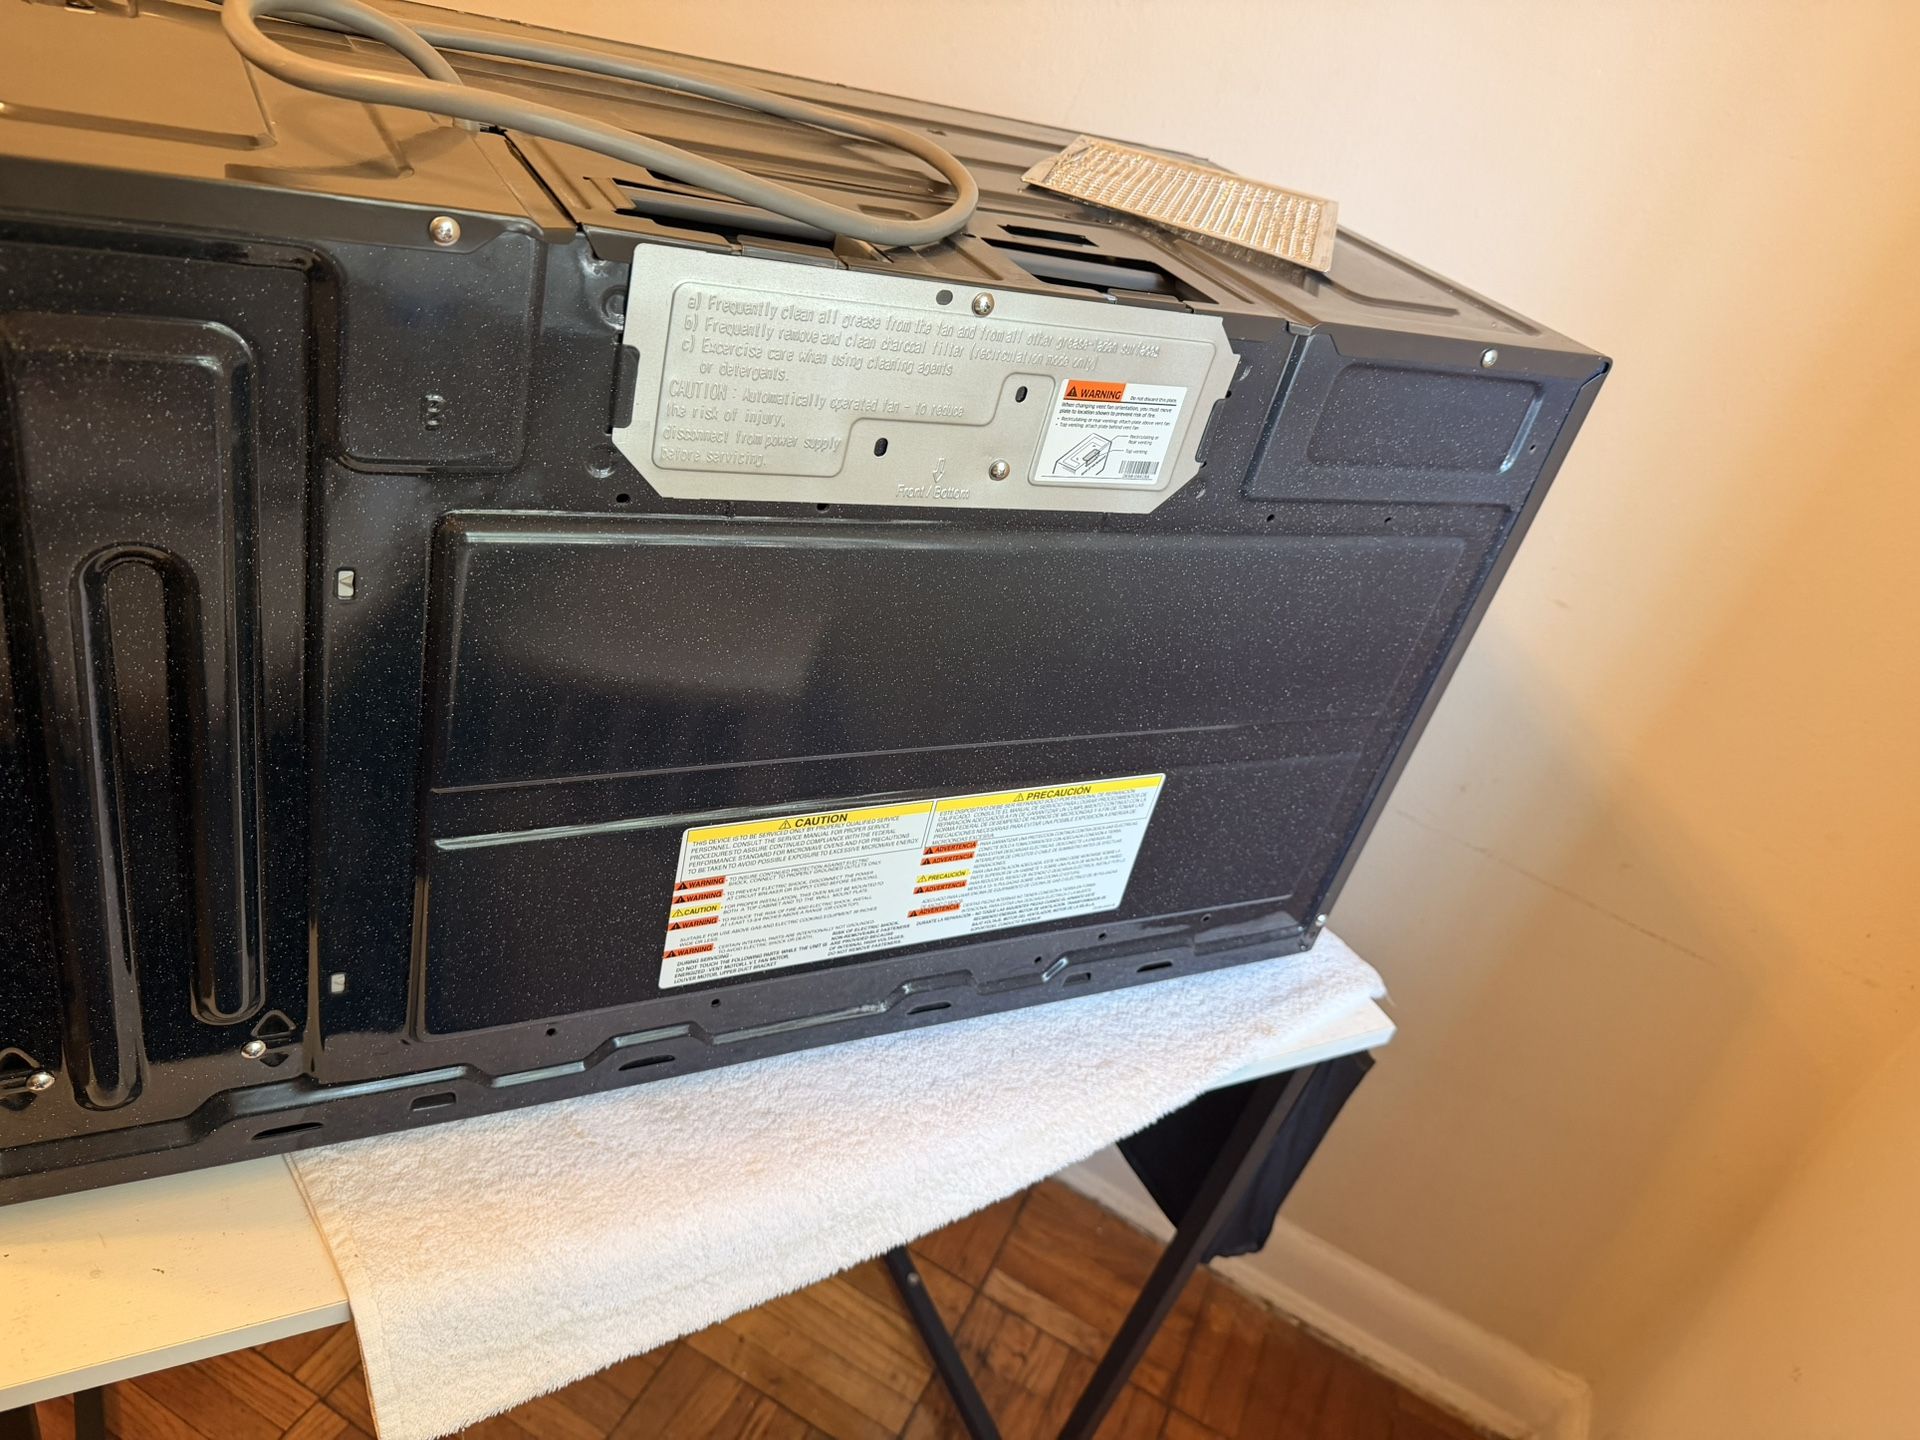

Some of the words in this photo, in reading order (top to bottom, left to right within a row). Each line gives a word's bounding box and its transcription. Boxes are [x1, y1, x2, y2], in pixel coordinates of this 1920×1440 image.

[688, 292, 701, 310] a)
[708, 295, 777, 320] Frequently
[781, 305, 814, 322] clean
[819, 309, 837, 325] all
[842, 314, 881, 329] grease
[886, 316, 911, 332] from
[914, 319, 932, 334] the
[936, 322, 953, 336] fan
[957, 325, 976, 339] and
[980, 326, 1006, 342] from
[1006, 328, 1024, 344] all
[1027, 332, 1052, 347] other
[684, 313, 698, 331] b)
[705, 316, 774, 341] Frequently
[778, 327, 819, 344] remove
[821, 331, 842, 346] and
[845, 334, 876, 349] clean
[881, 337, 926, 354] charcoal
[932, 342, 964, 358] filter
[1048, 354, 1069, 367] mode
[682, 334, 695, 352] c)
[768, 348, 794, 361] care
[799, 350, 827, 364] when
[832, 353, 863, 370] using
[867, 357, 914, 375] cleaning
[917, 360, 953, 376] agents
[700, 362, 713, 374] or
[719, 362, 789, 381] detergents.
[669, 380, 727, 400] CAUTION
[742, 387, 826, 410] Automatically
[830, 398, 878, 412] operated
[882, 399, 900, 413] fan
[931, 404, 964, 417] reduce
[1079, 388, 1121, 399] WARNING
[666, 403, 686, 418] the
[693, 406, 718, 420] risk
[724, 409, 737, 422] of
[663, 426, 729, 444] disconnect
[736, 432, 762, 445] from
[765, 434, 798, 448] power
[804, 436, 842, 452] supply
[661, 447, 700, 462] before
[707, 450, 767, 467] servicing.
[896, 484, 924, 498] Front
[933, 485, 970, 500] Bottom
[1025, 784, 1092, 800] PRECAUCIÓN
[758, 829, 788, 838] SERVICED
[815, 822, 845, 830] PROPERLY
[846, 818, 876, 826] QUALIFIED
[794, 813, 848, 827] CAUTION
[732, 839, 761, 848] CONSULT
[777, 834, 802, 842] SERVICE
[803, 830, 829, 839] MANUAL
[935, 841, 977, 852] ADVERTENCIA
[688, 856, 736, 867] PERFORMANCE
[738, 851, 772, 860] STANDARD
[786, 844, 822, 854] MICROWAVE
[870, 833, 909, 842] PRECAUTIONS
[690, 849, 733, 860] PROCEDURES
[742, 845, 767, 853] ASSURE
[768, 840, 805, 850] CONTINUED
[805, 835, 844, 845] COMPLIANCE
[706, 863, 727, 871] TAKEN
[757, 856, 786, 864] POSSIBLE
[787, 851, 820, 860] EXPOSURE
[829, 846, 860, 854] EXCESSIVE
[861, 841, 894, 850] MICROWAVE
[932, 852, 973, 863] ADVERTENCIA
[688, 877, 724, 888] WARNING
[925, 880, 966, 892] ADVERTENCIA
[686, 890, 722, 901] WARNING
[684, 904, 717, 915] CAUTION
[918, 903, 960, 915] ADVERTENCIA
[681, 917, 717, 928] WARNING
[676, 944, 712, 956] WARNING
[700, 953, 728, 962] SERVICING
[731, 953, 762, 962] FOLLOWING
